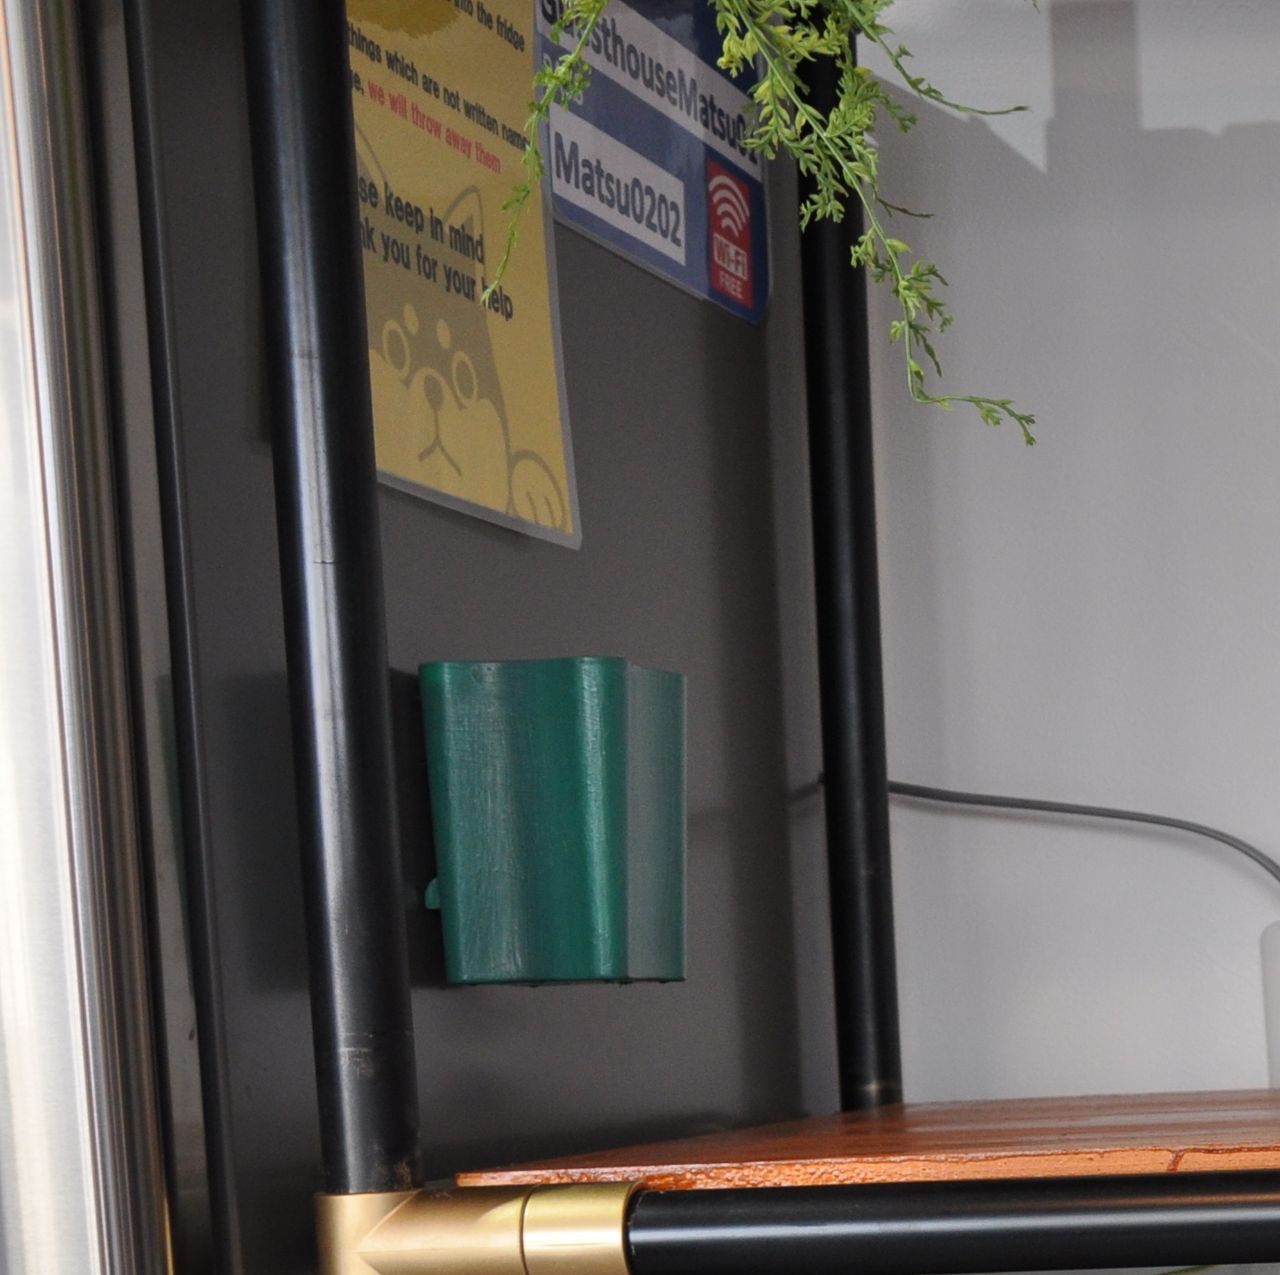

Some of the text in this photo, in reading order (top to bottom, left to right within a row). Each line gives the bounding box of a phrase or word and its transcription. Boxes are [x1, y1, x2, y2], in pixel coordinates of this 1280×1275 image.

[476, 2, 493, 31] the
[497, 15, 525, 52] fridge
[368, 79, 385, 106] we
[389, 92, 407, 120] will
[411, 102, 442, 141] throw
[445, 127, 472, 160] away
[475, 141, 501, 175] them
[385, 50, 418, 86] which
[422, 74, 440, 99] are
[443, 87, 461, 112] not
[463, 99, 499, 136] written
[384, 181, 424, 235] keep
[430, 206, 444, 244] in
[448, 223, 485, 265] mind
[554, 131, 682, 248] Matsu0202
[381, 232, 411, 271] you
[416, 244, 438, 283] for
[443, 263, 476, 302] your
[481, 276, 513, 321] help
[719, 270, 744, 299] FREE
